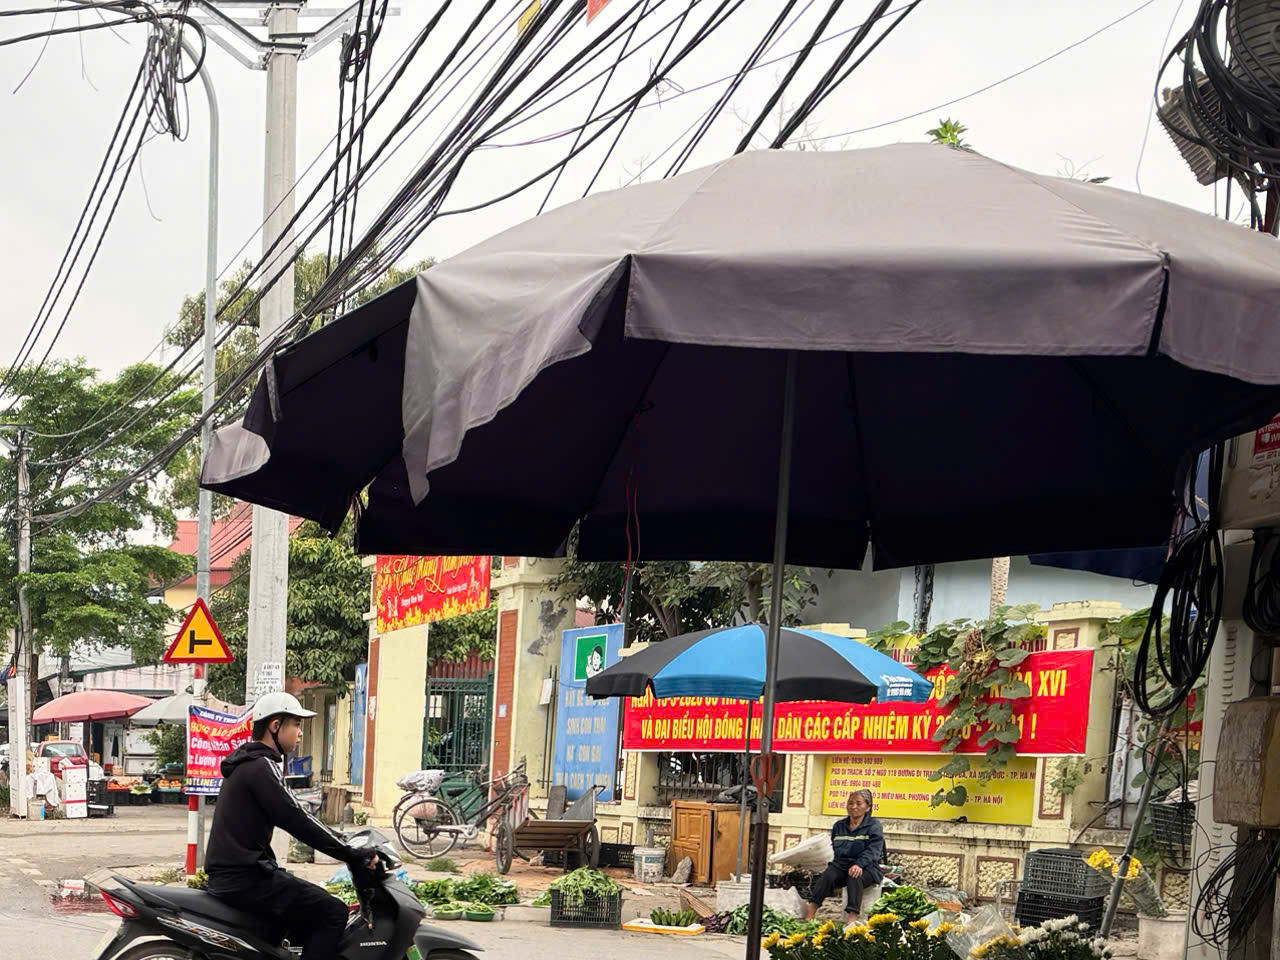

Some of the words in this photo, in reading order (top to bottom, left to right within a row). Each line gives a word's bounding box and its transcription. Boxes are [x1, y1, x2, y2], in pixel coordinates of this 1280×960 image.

[1037, 669, 1067, 697] XVI
[641, 715, 653, 739] VÀ
[654, 718, 670, 744] ĐẠI
[672, 711, 693, 739] BIỂU
[696, 714, 713, 744] HỘI
[714, 711, 743, 739] ĐỒNG
[777, 713, 802, 739] DÂN
[804, 711, 830, 739] CÁC
[833, 708, 860, 740] CẤP
[863, 711, 909, 745] NHIỆM
